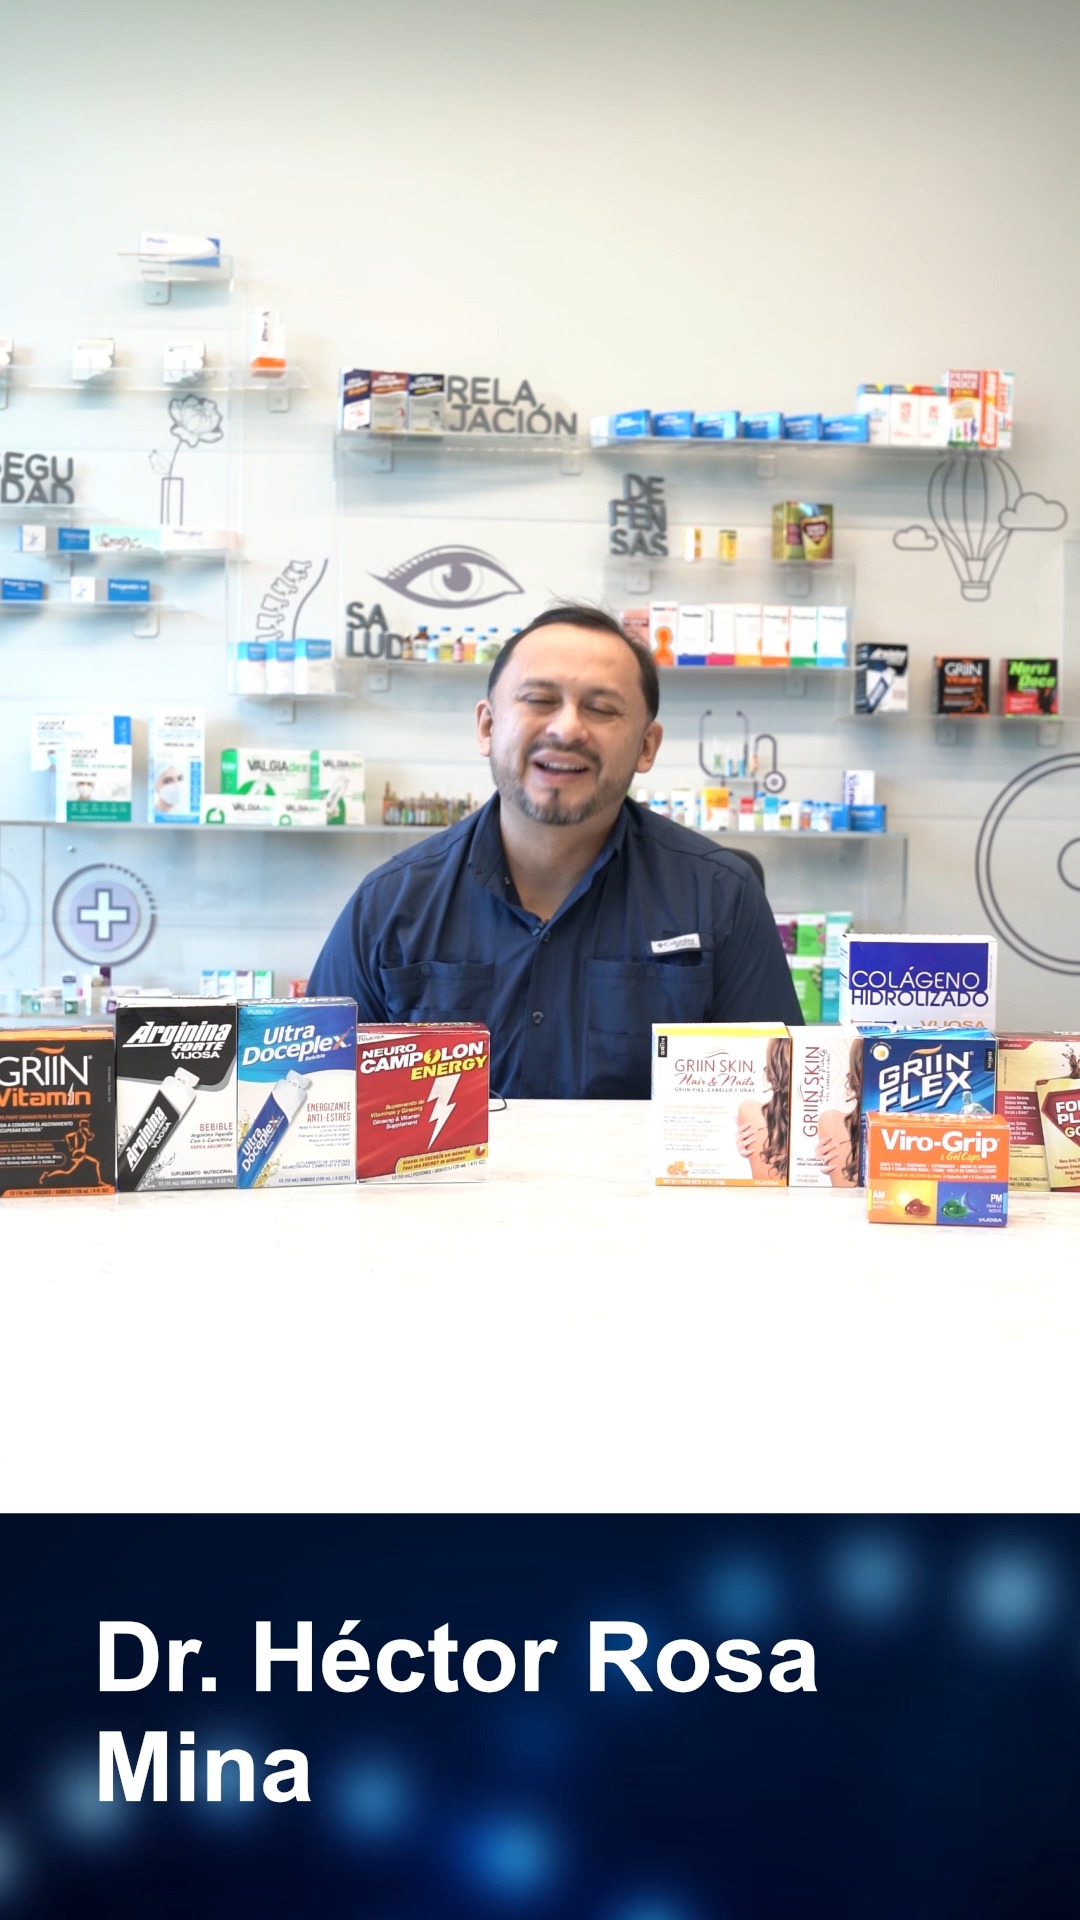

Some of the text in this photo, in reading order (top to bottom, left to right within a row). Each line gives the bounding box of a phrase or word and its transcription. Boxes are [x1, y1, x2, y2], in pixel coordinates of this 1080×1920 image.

[448, 375, 537, 407] RELA
[450, 404, 578, 435] JACIÓN
[0, 452, 74, 482] EGU
[624, 473, 664, 503] DE
[609, 499, 667, 532] FEN
[610, 528, 668, 556] SAS
[346, 601, 388, 631] SA
[346, 630, 404, 660] LUD
[1010, 661, 1050, 675] Nervi
[852, 966, 980, 989] COLÁGENO
[851, 990, 989, 1007] HIDROLIZADO
[122, 1020, 232, 1048] Arginina
[171, 1042, 225, 1052] FORTE
[242, 1028, 351, 1066] Doceplex
[263, 1024, 315, 1045] Ultra
[171, 1051, 220, 1059] VIJOSA
[360, 1041, 484, 1074] CAMPOLON
[362, 1043, 417, 1059] NEURO
[0, 1055, 88, 1087] GRIIN
[411, 1055, 488, 1080] ENERGY
[675, 1059, 754, 1073] GRIIN SKIN
[675, 1073, 754, 1086] Hair & Nails
[878, 1052, 970, 1090] GRIIN
[803, 1046, 820, 1137] GRIIN SKIN
[879, 1070, 972, 1113] FLEX
[307, 1102, 351, 1112] ENERGIZANTE
[307, 1112, 351, 1122] ANTI-ESTRÉS
[1056, 1101, 1080, 1113] FO
[126, 1106, 166, 1172] Arginina
[200, 1122, 233, 1131] BEBIBLE
[242, 1128, 262, 1156] Ultra
[881, 1129, 998, 1158] Viro-Grip
[990, 1194, 1002, 1203] PM
